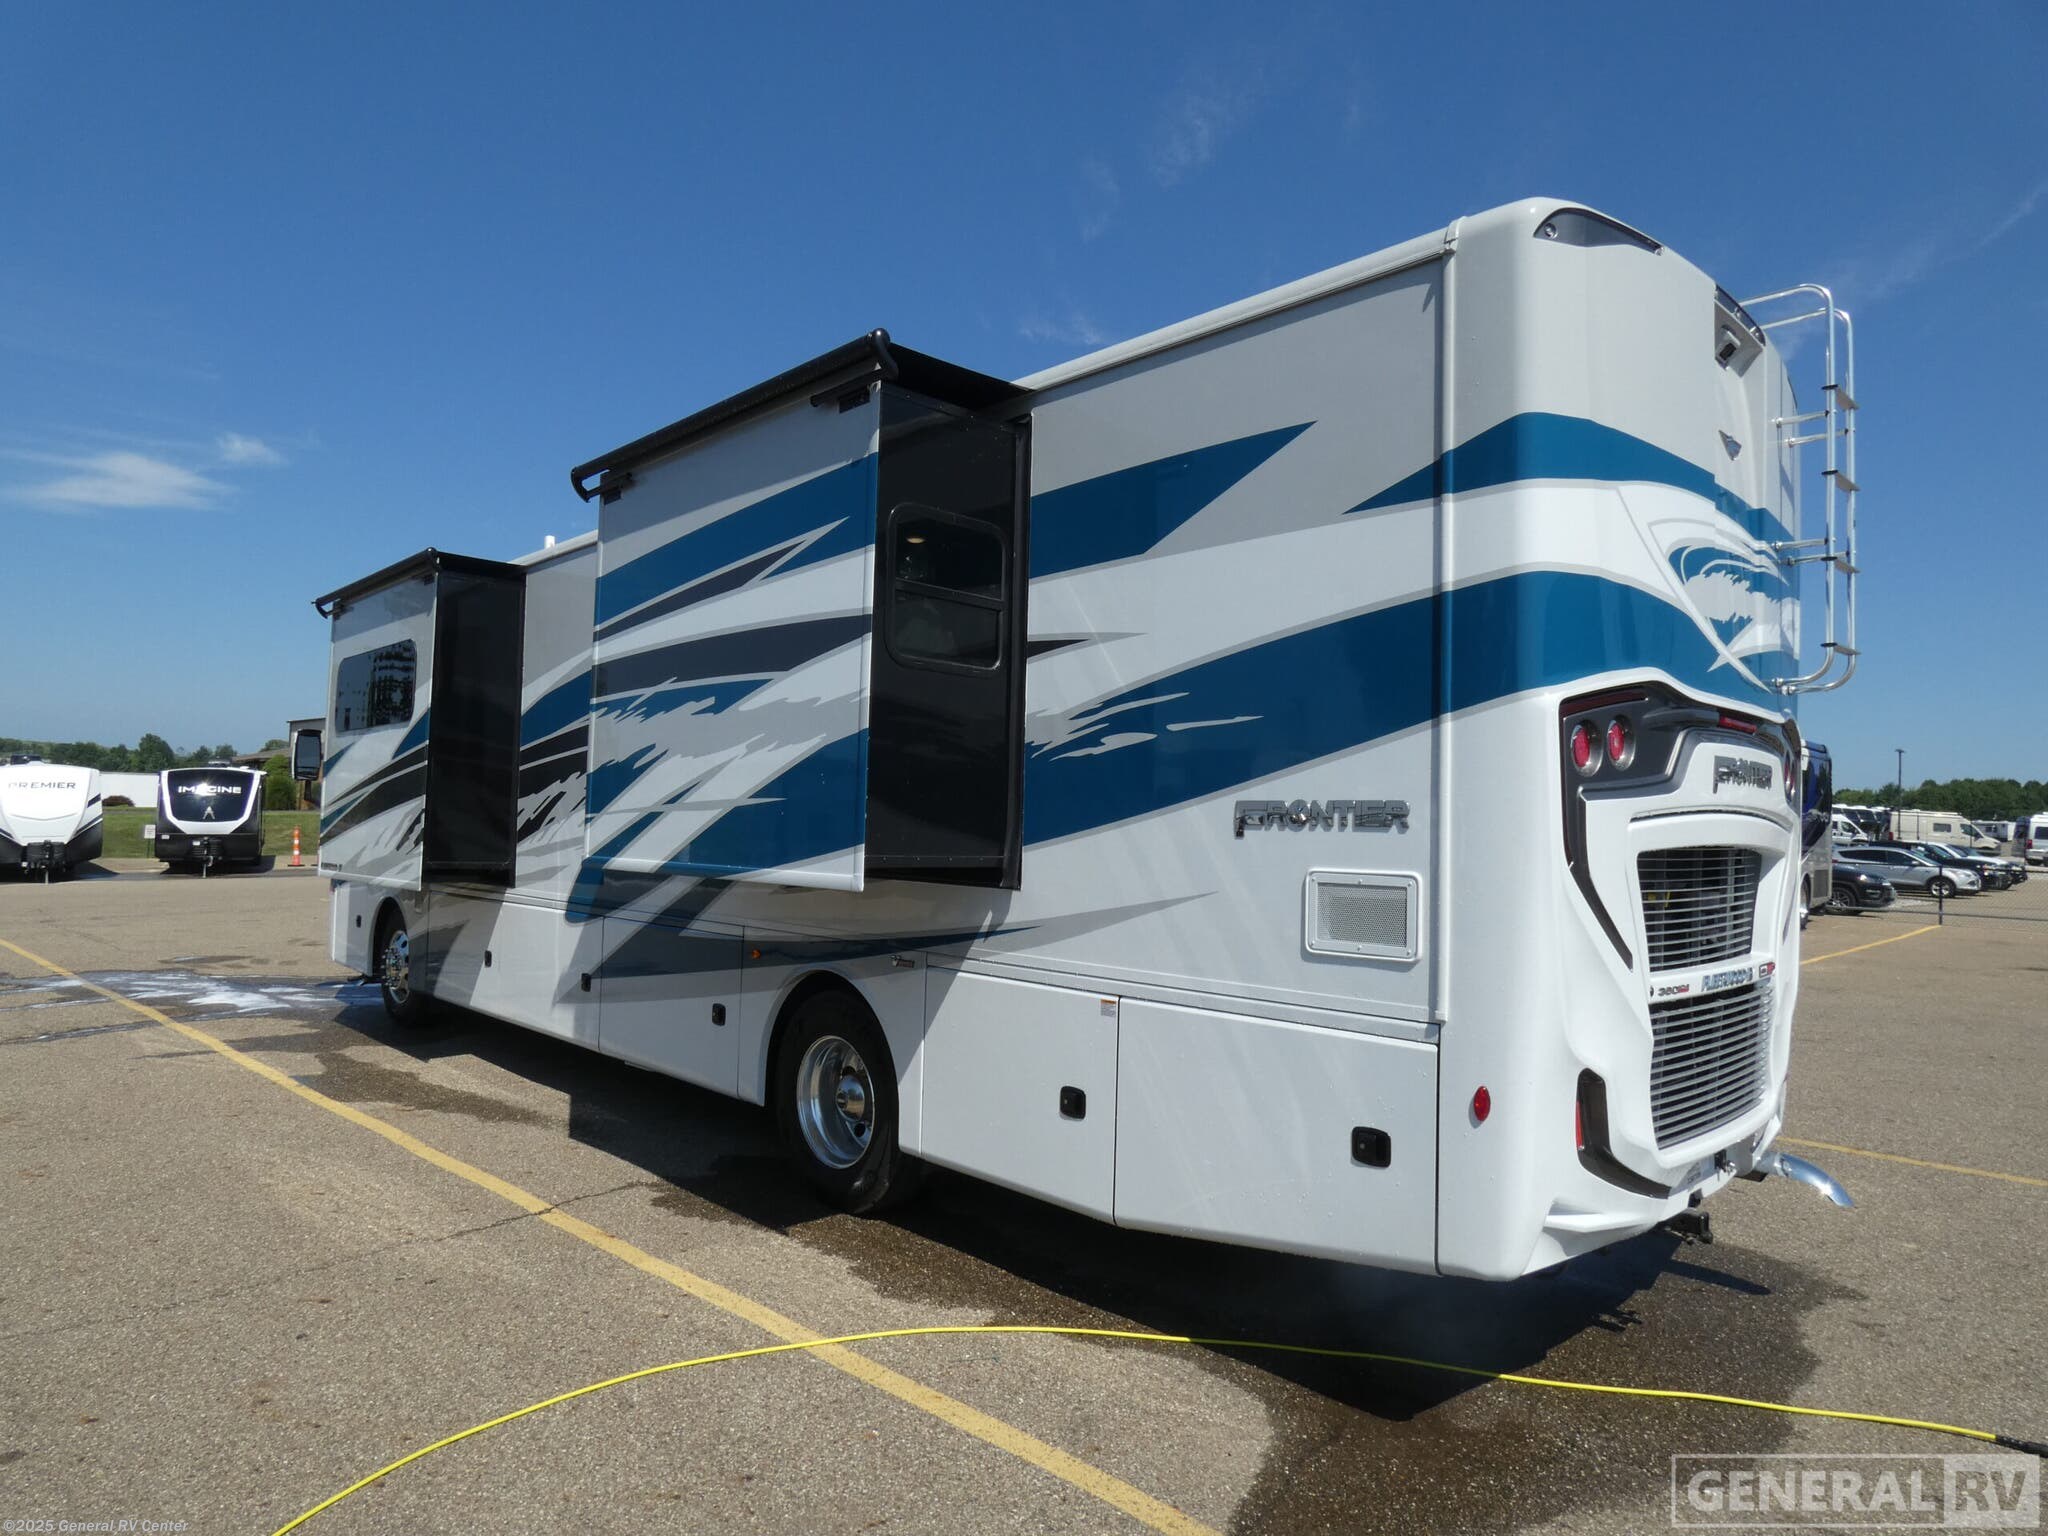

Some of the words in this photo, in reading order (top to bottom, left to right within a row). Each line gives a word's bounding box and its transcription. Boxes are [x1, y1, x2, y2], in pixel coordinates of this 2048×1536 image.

[8, 782, 76, 790] PREMIER
[1713, 755, 1773, 794] FRONTIER
[178, 785, 242, 794] IMGINE
[1233, 799, 1410, 839] FRONTIER
